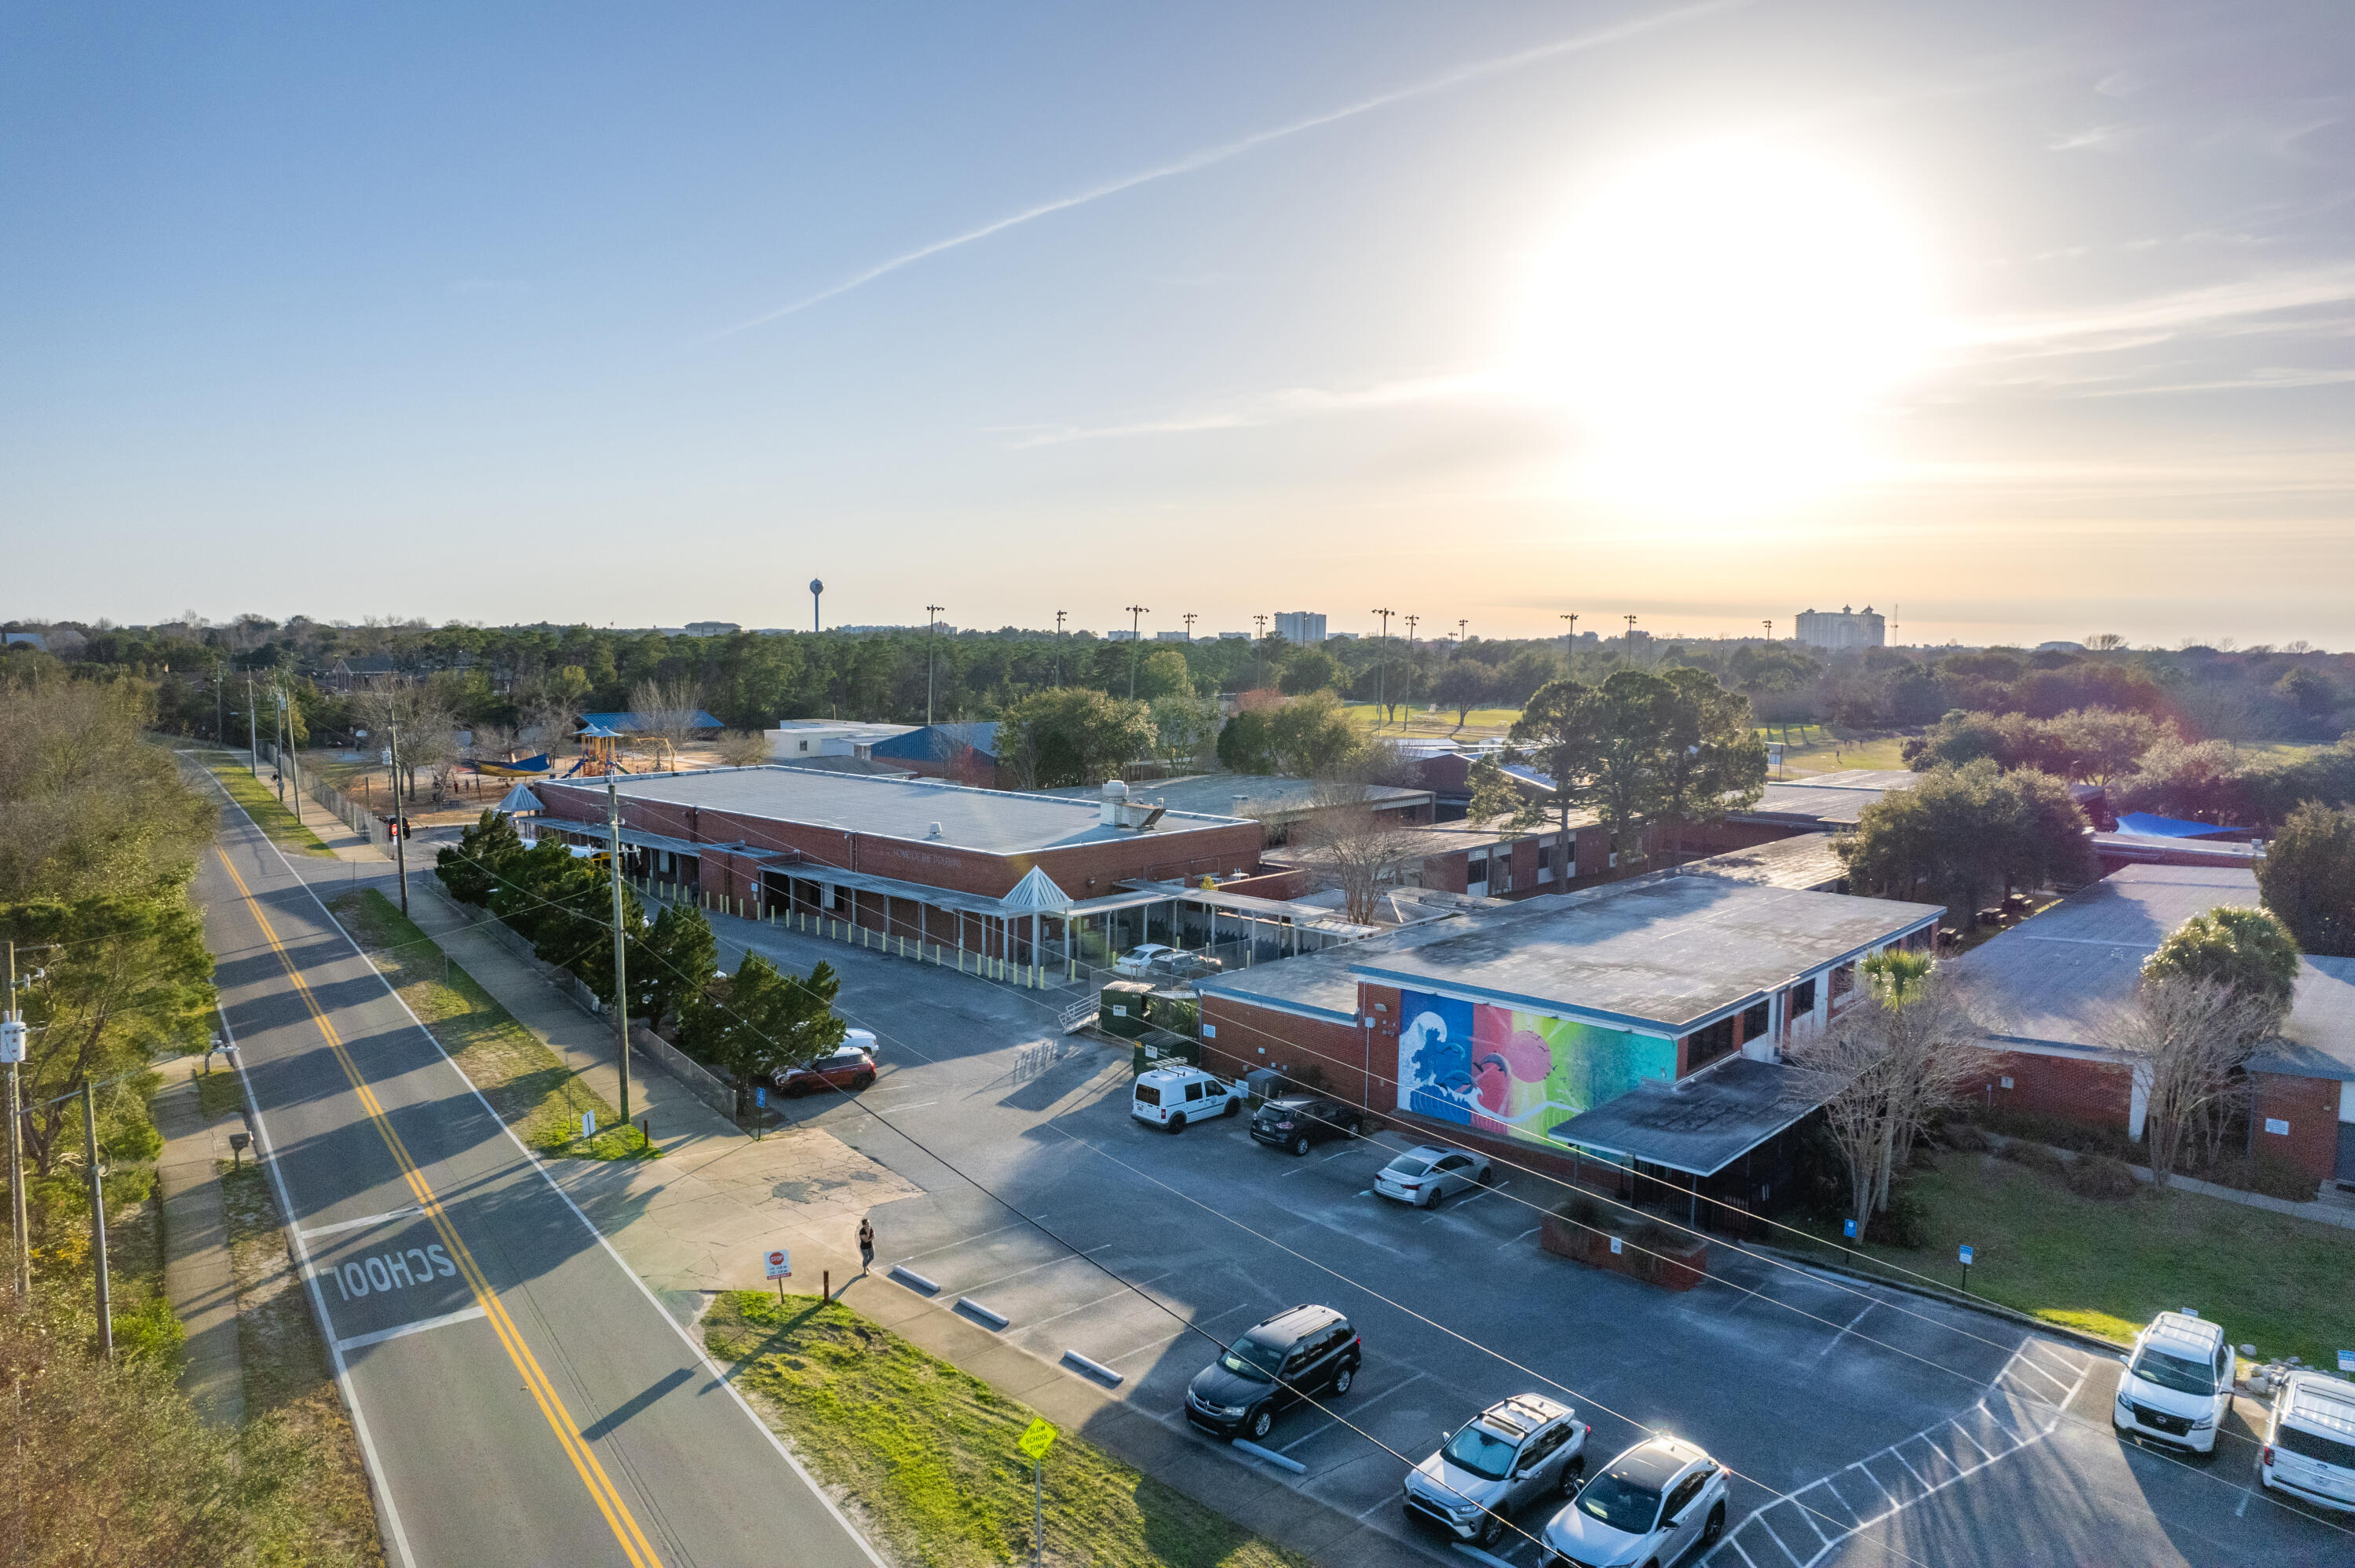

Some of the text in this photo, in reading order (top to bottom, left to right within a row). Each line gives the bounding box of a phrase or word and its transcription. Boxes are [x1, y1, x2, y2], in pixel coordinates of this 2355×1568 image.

[893, 849, 911, 859] HOME
[922, 853, 932, 862] THE
[319, 1244, 456, 1301] SCHOOL
[1029, 1425, 1045, 1434] SLOW
[1025, 1433, 1049, 1444] SCHOOL
[1030, 1442, 1045, 1452] ZONE
